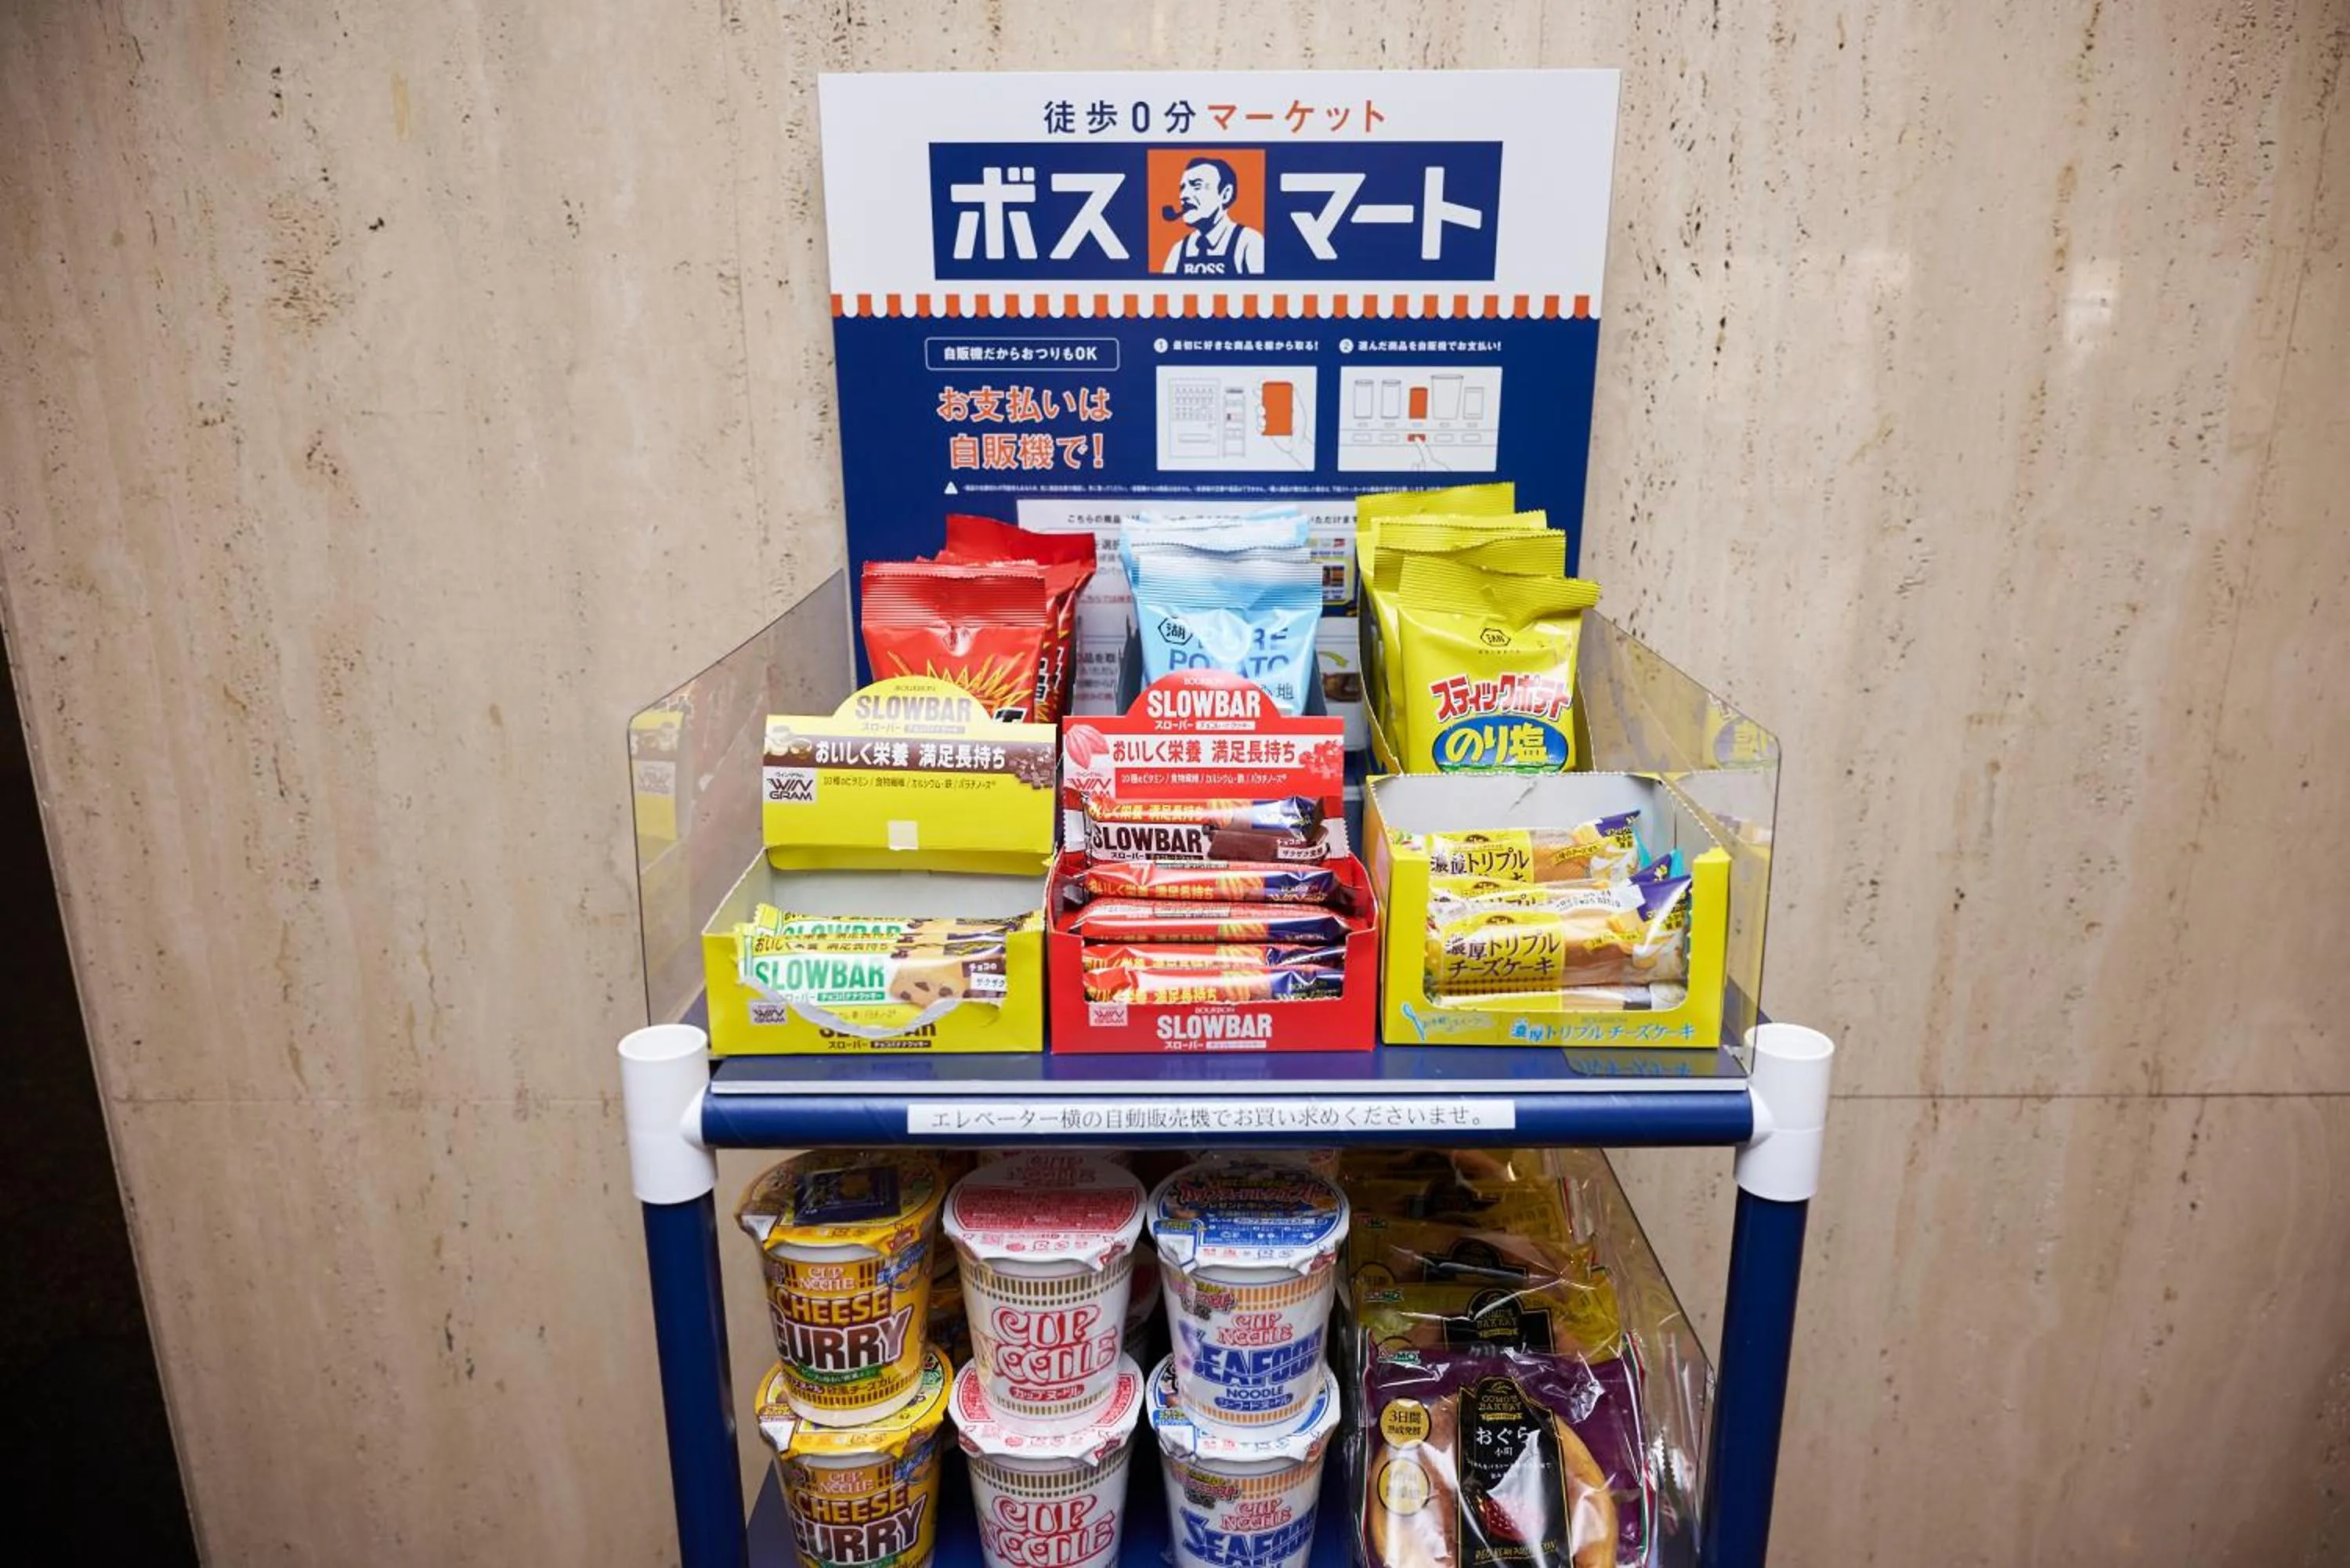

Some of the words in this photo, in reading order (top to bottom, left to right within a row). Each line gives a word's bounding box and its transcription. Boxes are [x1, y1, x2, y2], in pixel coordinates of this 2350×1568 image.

[951, 165, 1130, 260] ボス
[1279, 165, 1483, 260] マート
[944, 346, 1097, 361] 自販機だからおつりもOK
[937, 385, 1112, 422] お支払いは
[949, 433, 1104, 469] 自販機で!
[855, 695, 972, 722] SLOWBAR
[1147, 690, 1261, 718] SLOWBAR
[1430, 674, 1572, 722] スティックポテト
[1155, 720, 1194, 730] スローバー
[815, 740, 909, 768] おいしく栄養
[919, 743, 1007, 769] 満足長持ち
[1113, 739, 1201, 764] おいしく栄養
[1211, 740, 1296, 765] 満足長持ち
[1445, 724, 1547, 764] のり塩
[766, 778, 814, 791] WIN
[769, 790, 812, 800] GRAM
[1092, 824, 1203, 854] SLOWBAR
[1110, 851, 1145, 860] スローバー
[1444, 930, 1561, 961] 濃厚トリプル
[755, 959, 885, 991] SLOWBAR
[1448, 956, 1556, 979] チーズケーキ
[1156, 1013, 1273, 1039] SLOWBAR
[1510, 1018, 1603, 1042] 濃厚トリプル
[1608, 1023, 1695, 1041] チーズケーキ
[828, 1041, 868, 1050] スローバー
[1164, 1040, 1204, 1050] スローバー
[932, 1105, 1484, 1129] エレベーター横の自動販売機でお買い求めくださいませ。
[776, 1286, 891, 1325] CHEESE
[992, 1304, 1101, 1349] CUP
[1217, 1323, 1294, 1346] NOODLE
[1231, 1312, 1283, 1331] CUP
[769, 1303, 914, 1373] CURRY
[1226, 1386, 1284, 1398] NOODLE
[1389, 1410, 1422, 1424] 3日間
[1475, 1425, 1530, 1446] おぐら
[794, 1485, 909, 1523] CHEESE
[992, 1494, 1097, 1536] CUP
[1235, 1497, 1283, 1516] CUP
[790, 1493, 928, 1565] CURRY
